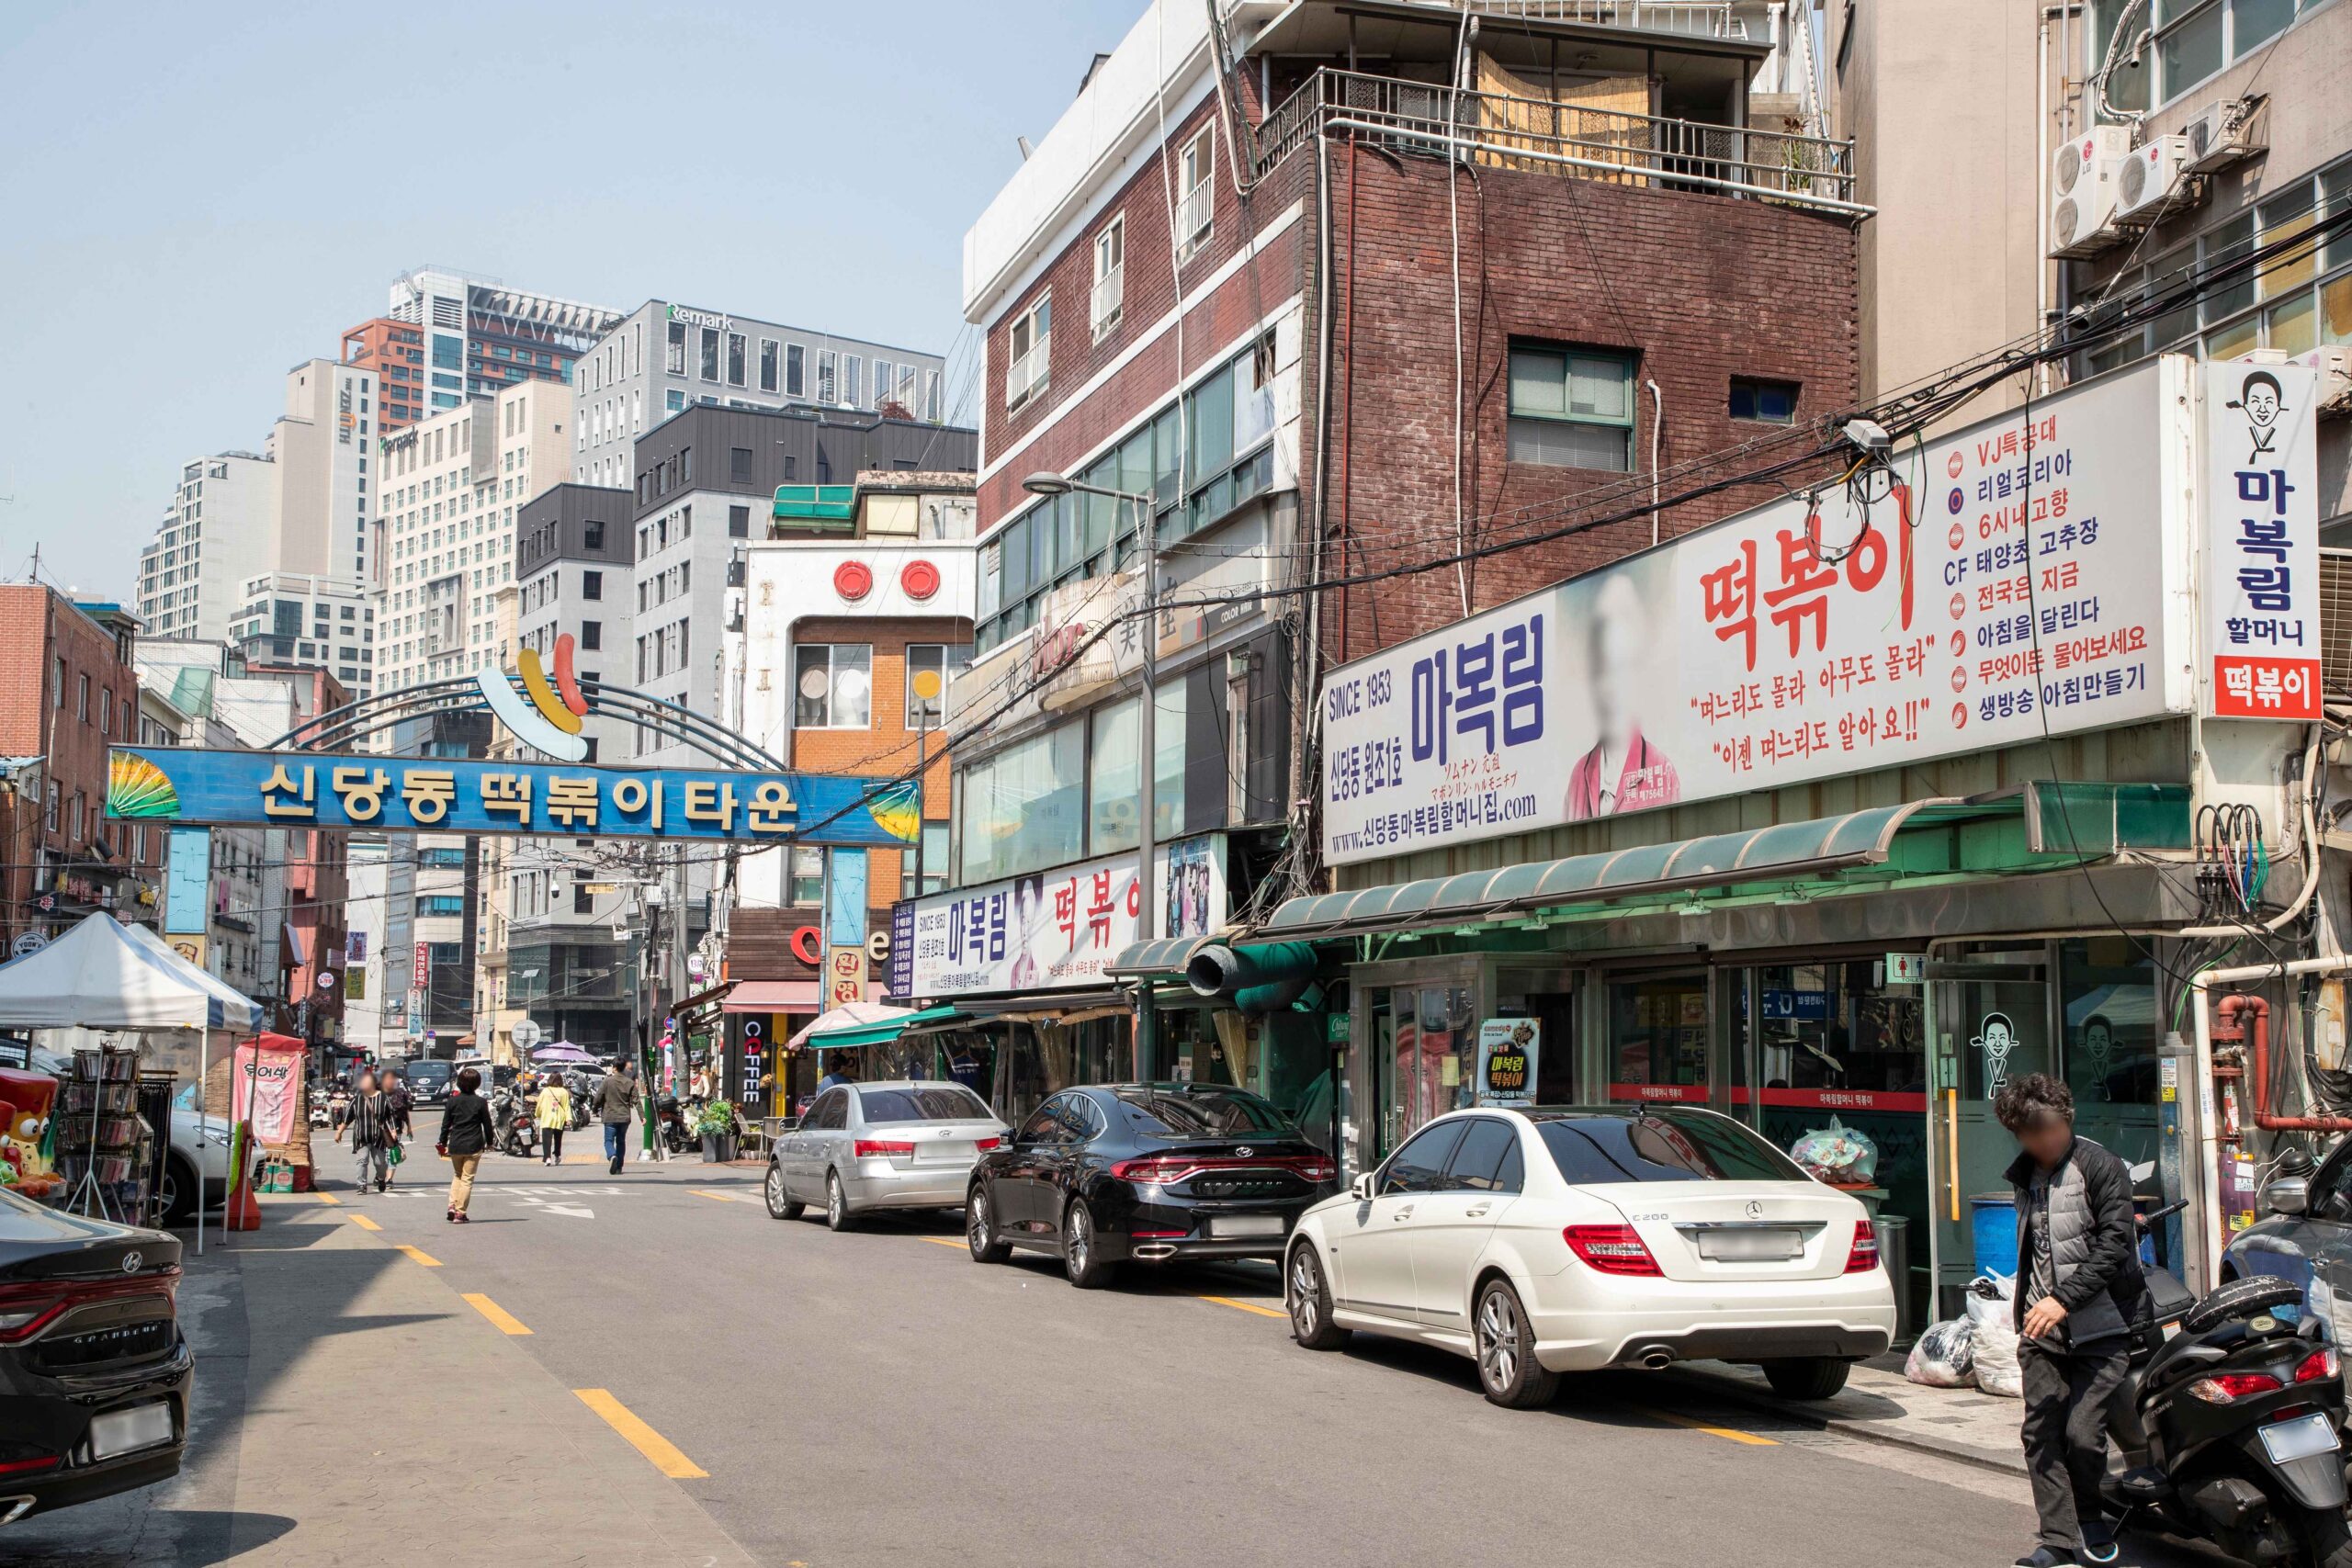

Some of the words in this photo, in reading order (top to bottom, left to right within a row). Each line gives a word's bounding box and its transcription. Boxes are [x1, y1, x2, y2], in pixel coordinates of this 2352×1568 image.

[2082, 163, 2092, 175] LG
[666, 302, 734, 332] Remark
[1977, 414, 2057, 468] VJ특공대
[1978, 448, 2073, 502] 리얼코리아
[1979, 488, 2069, 539] 6시내고향
[2233, 468, 2295, 611] 마복림
[1944, 558, 1968, 586] CF
[1976, 538, 2031, 574] 태양초
[2039, 516, 2099, 557] 고추장
[1700, 484, 1914, 672] 떡볶이
[1977, 575, 2031, 612] 전국은
[2041, 560, 2080, 592] 지금
[1221, 606, 1239, 624] COLOR
[1977, 614, 2032, 649] 아침을
[2041, 596, 2100, 636] 달린다
[2225, 617, 2303, 647] 할머니
[1771, 670, 1806, 709] 몰라
[1819, 654, 1876, 699] 아무도
[1978, 648, 2045, 685] 무엇이든
[2053, 626, 2148, 671] 물어보세요
[1329, 679, 1360, 722] SINCE
[1366, 669, 1391, 709] 1953
[1411, 613, 1544, 766] 마복림
[1979, 688, 2034, 722] 생방송
[2043, 663, 2145, 708] 아침만들기
[2224, 664, 2311, 710] 떡볶이
[1331, 746, 1360, 802] 신당동
[1364, 737, 1402, 795] 원조1호
[1761, 721, 1830, 766] 며느리도
[260, 764, 456, 824] 신당동
[1332, 792, 1537, 853] www.신당동마복림할머니집.com
[948, 891, 1008, 965] 마복림
[742, 1021, 761, 1103] COFFEE
[1491, 1056, 1524, 1072] 마복림
[1491, 1072, 1523, 1088] 떡볶이
[1820, 1093, 1853, 1104] 마복림할머니
[1855, 1094, 1873, 1105] 떡볶이
[2265, 1354, 2294, 1366] SUZUKI
